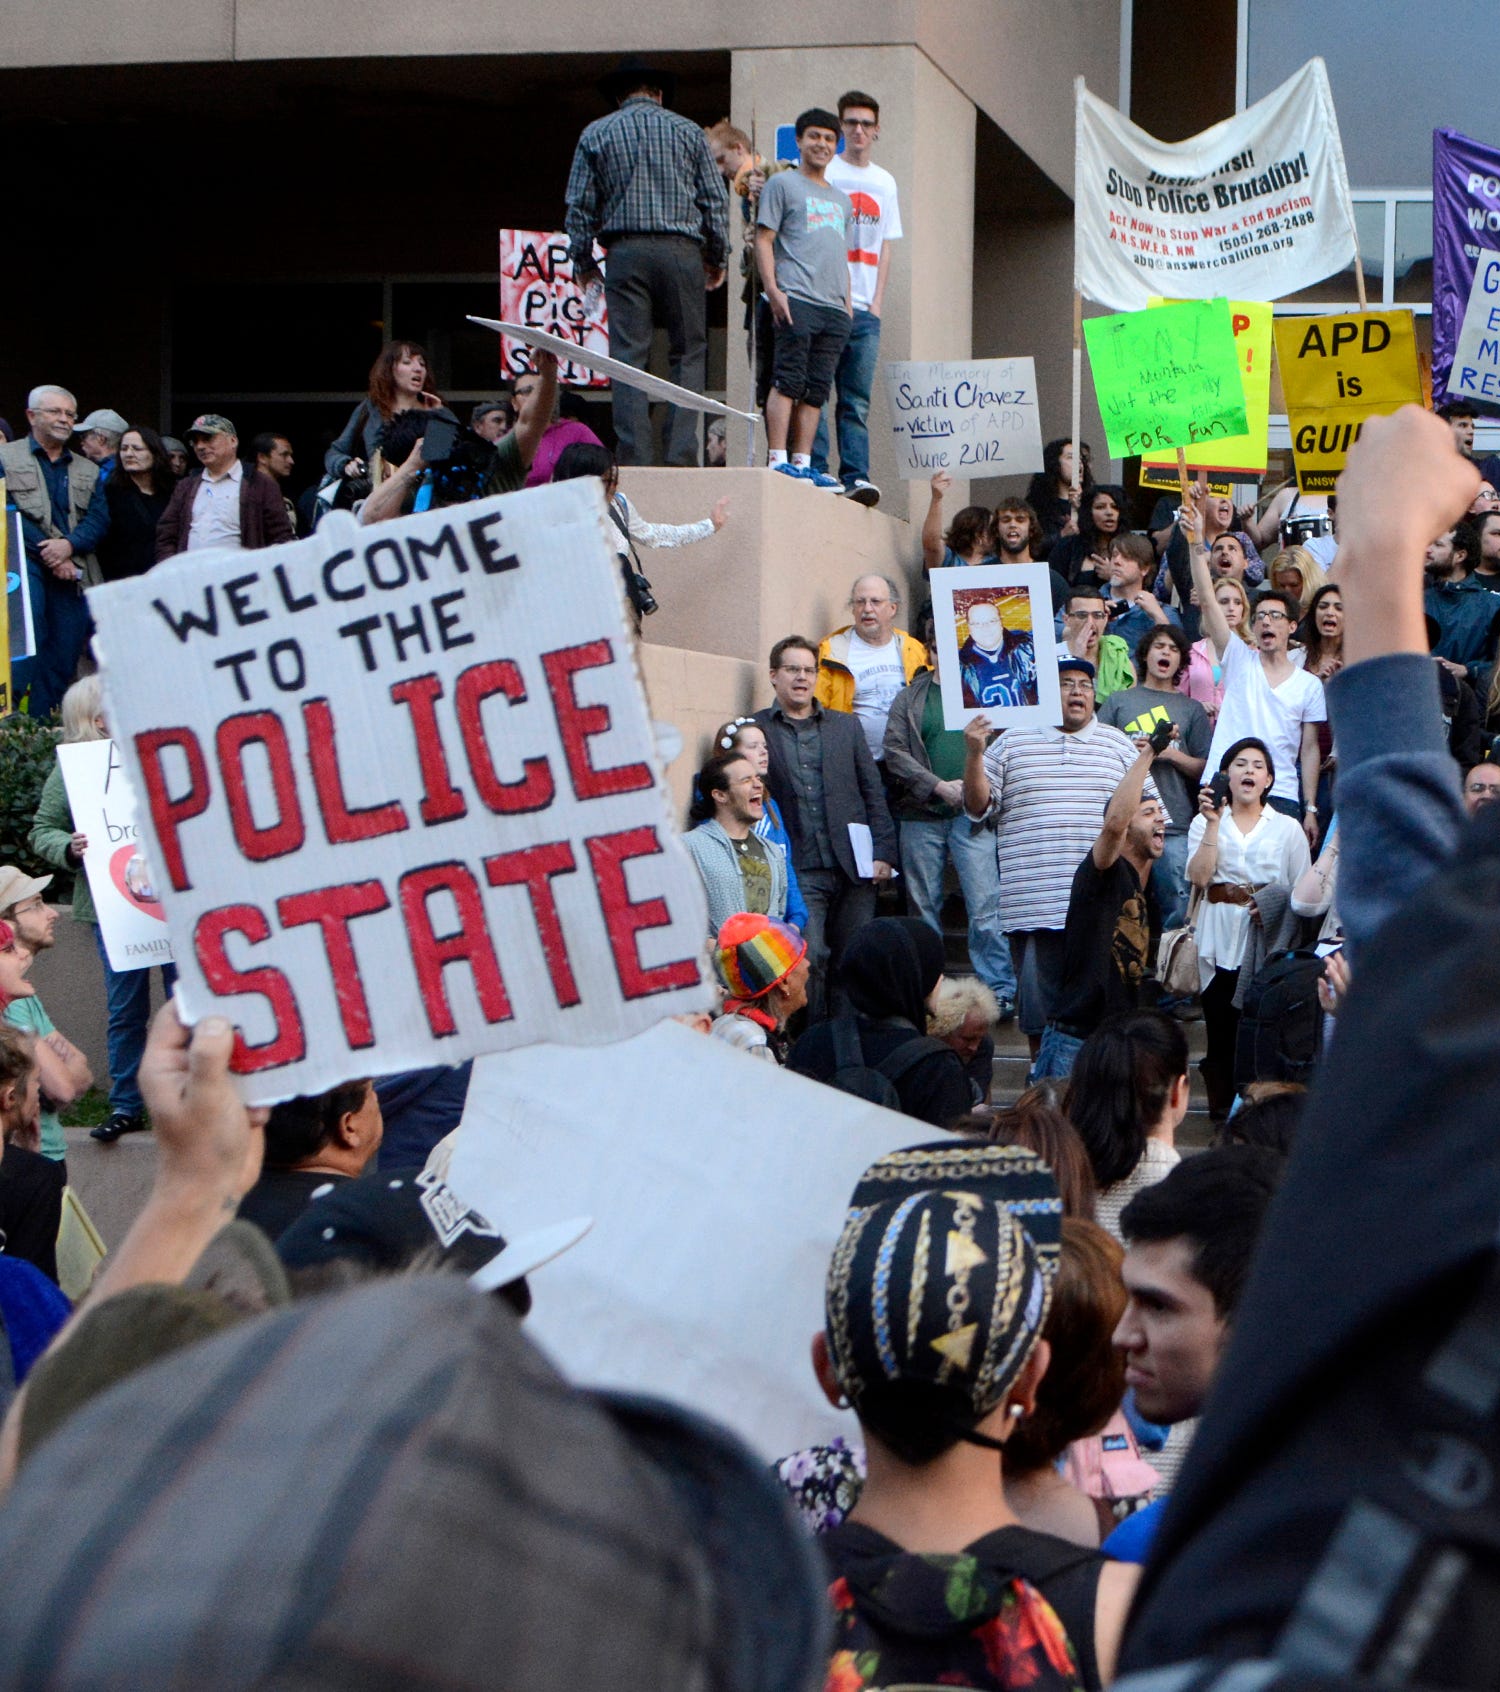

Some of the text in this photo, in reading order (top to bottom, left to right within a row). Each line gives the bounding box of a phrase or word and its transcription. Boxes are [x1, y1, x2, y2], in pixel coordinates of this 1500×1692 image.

[1106, 152, 1310, 215] Stop Police Brutality!
[1109, 210, 1127, 227] Act
[1170, 230, 1198, 241] Stop
[1202, 223, 1227, 239] War
[1243, 212, 1265, 228] End
[1267, 194, 1312, 219] Racism
[1176, 246, 1196, 257] NM
[1219, 235, 1254, 253] (505)
[1298, 319, 1391, 359] APD
[896, 381, 1034, 411] Santi Chavez
[1336, 371, 1363, 398] is
[986, 411, 1025, 431] APD
[1124, 424, 1173, 457] FOR
[908, 440, 1006, 469] June 2012
[152, 511, 521, 643] WELCOME
[214, 588, 476, 701] TO THE
[134, 638, 656, 893] POLICE
[194, 825, 702, 1075] STATE
